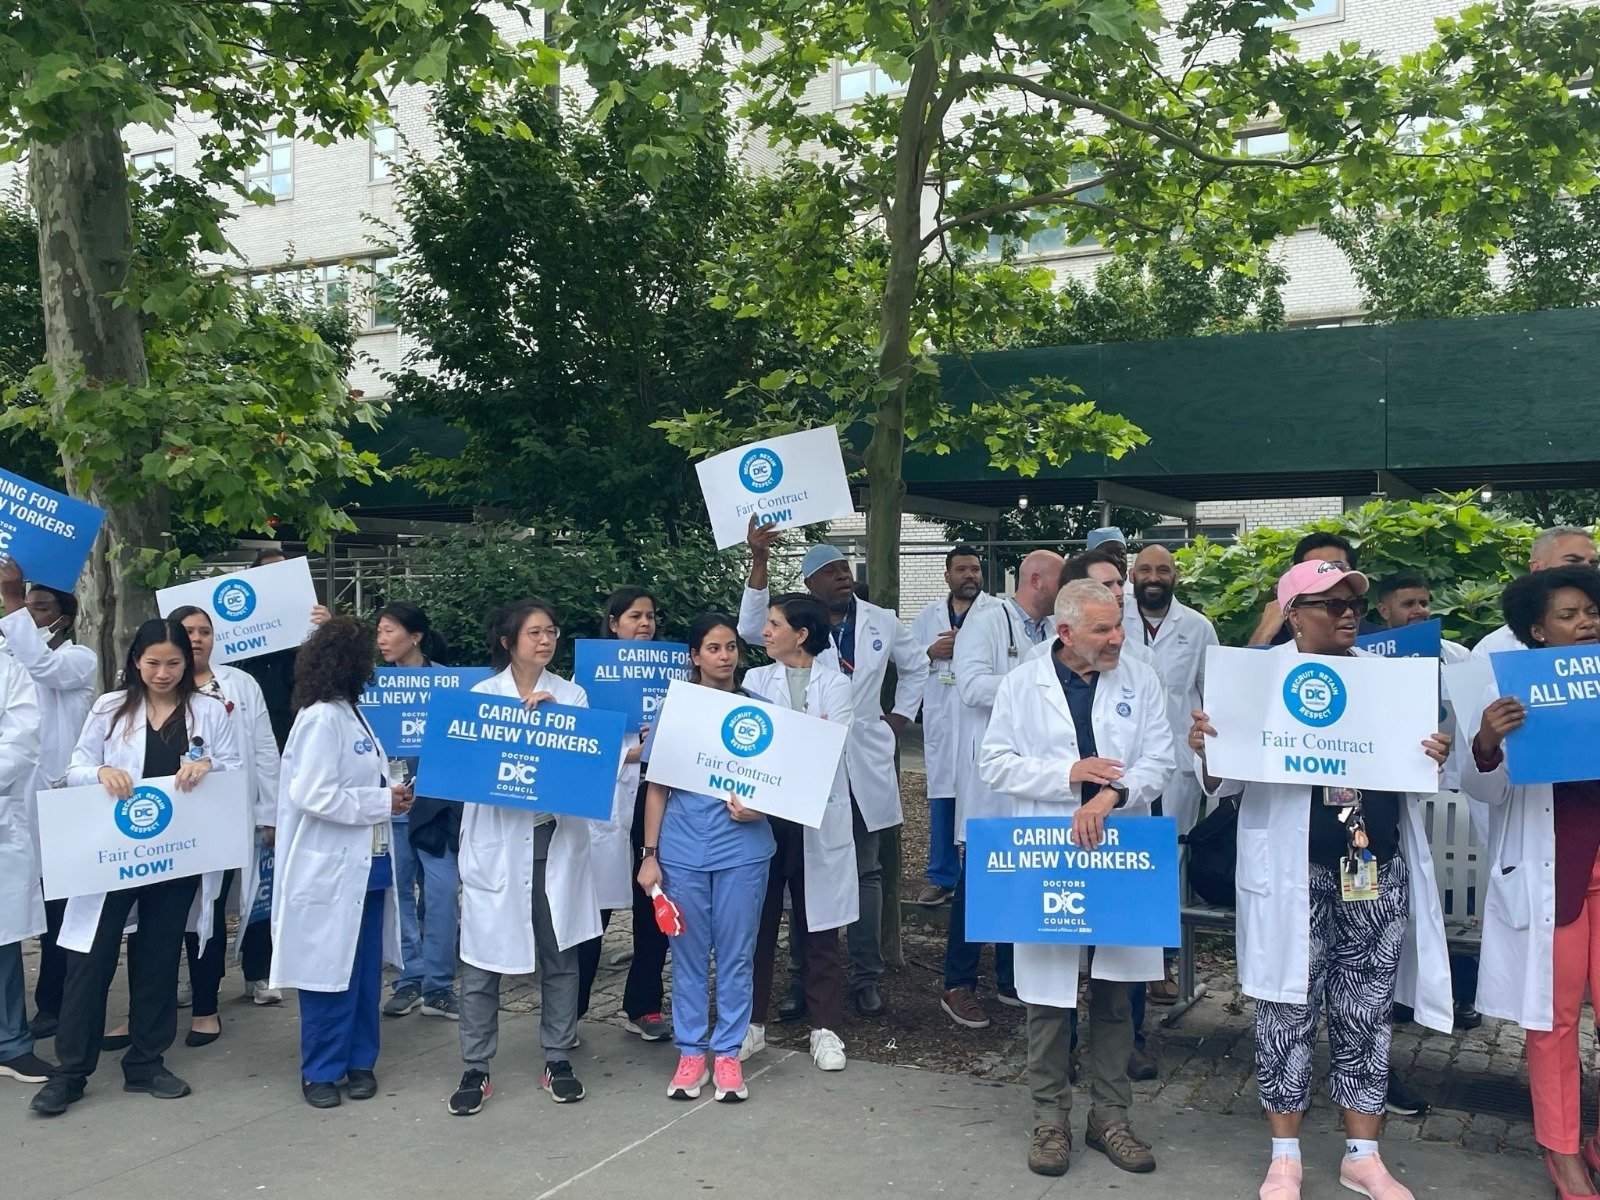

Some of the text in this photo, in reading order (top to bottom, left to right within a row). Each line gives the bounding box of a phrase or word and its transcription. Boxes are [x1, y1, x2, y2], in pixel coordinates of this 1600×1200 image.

[0, 478, 28, 501] ING
[28, 492, 59, 514] FOR
[736, 491, 809, 516] Fair Contract
[0, 521, 17, 532] TORS
[9, 501, 76, 540] YORKERS.
[215, 619, 282, 641] air Contract
[224, 636, 267, 655] NOW!
[618, 648, 668, 664] CARING
[1367, 639, 1397, 656] FOR
[594, 665, 691, 681] ALL NEW YORK
[1554, 656, 1600, 677] CARI
[378, 675, 460, 688] CARING FOR
[1291, 670, 1339, 696] RECRUIT RETAIN
[382, 692, 416, 704] NEW
[1530, 683, 1567, 704] ALL
[478, 703, 577, 731] CARING FOR
[1299, 706, 1332, 720] RESPECT
[448, 719, 602, 755] ALL NEW YORKERS.
[730, 738, 757, 752] RESPECT
[1261, 731, 1374, 754] Fair Contract
[501, 752, 540, 762] DOCTORS
[1284, 755, 1346, 776] NOW!
[696, 752, 783, 787] Fair Contract
[496, 783, 534, 794] COUNCIL
[709, 774, 756, 799] NOW!
[129, 822, 160, 834] RESPECT
[98, 838, 197, 864] Fair Contract
[987, 851, 1156, 870] ALL NEW YORKERS.
[119, 858, 174, 880] NOW!
